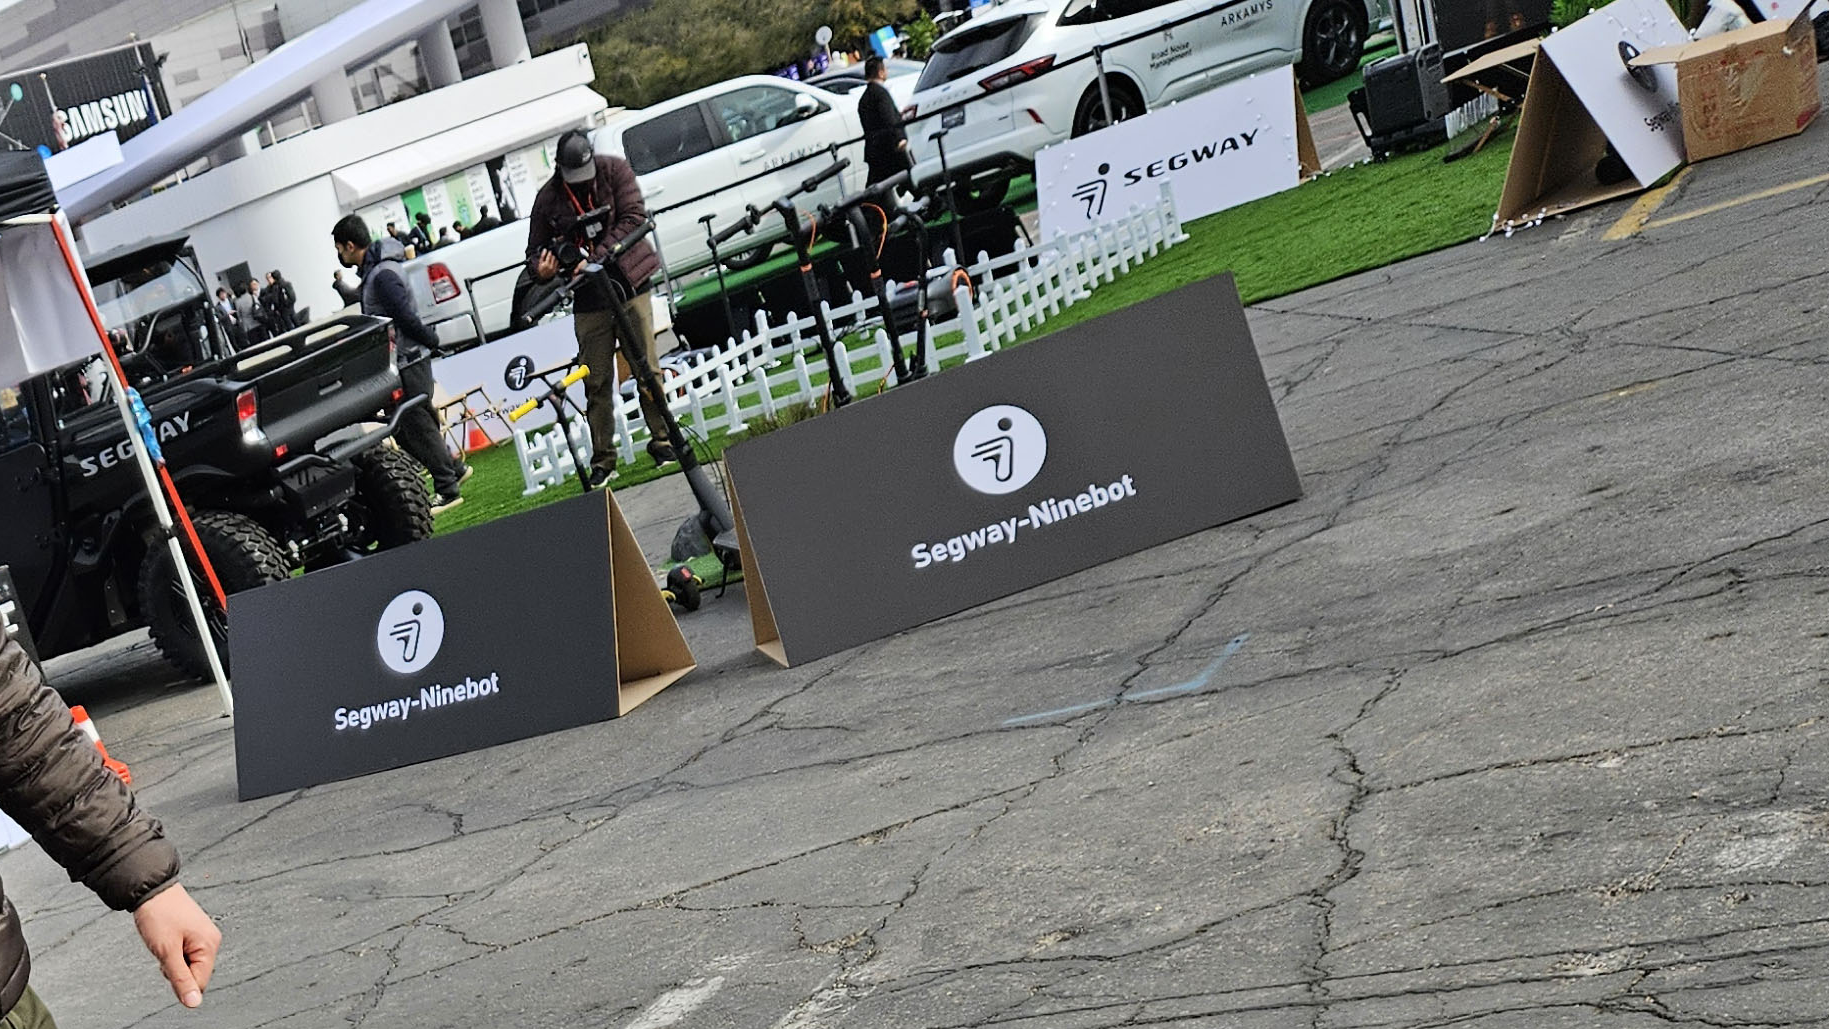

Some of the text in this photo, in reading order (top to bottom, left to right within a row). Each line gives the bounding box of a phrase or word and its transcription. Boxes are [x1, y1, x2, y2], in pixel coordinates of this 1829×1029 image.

[1220, 0, 1274, 27] ARKAMYS
[53, 89, 149, 142] SAMSUN
[1124, 128, 1259, 187] SEGWAY
[79, 411, 189, 478] SEGAY
[911, 474, 1137, 569] Segway-Ninebot
[334, 672, 500, 731] Segway-Ninebot
